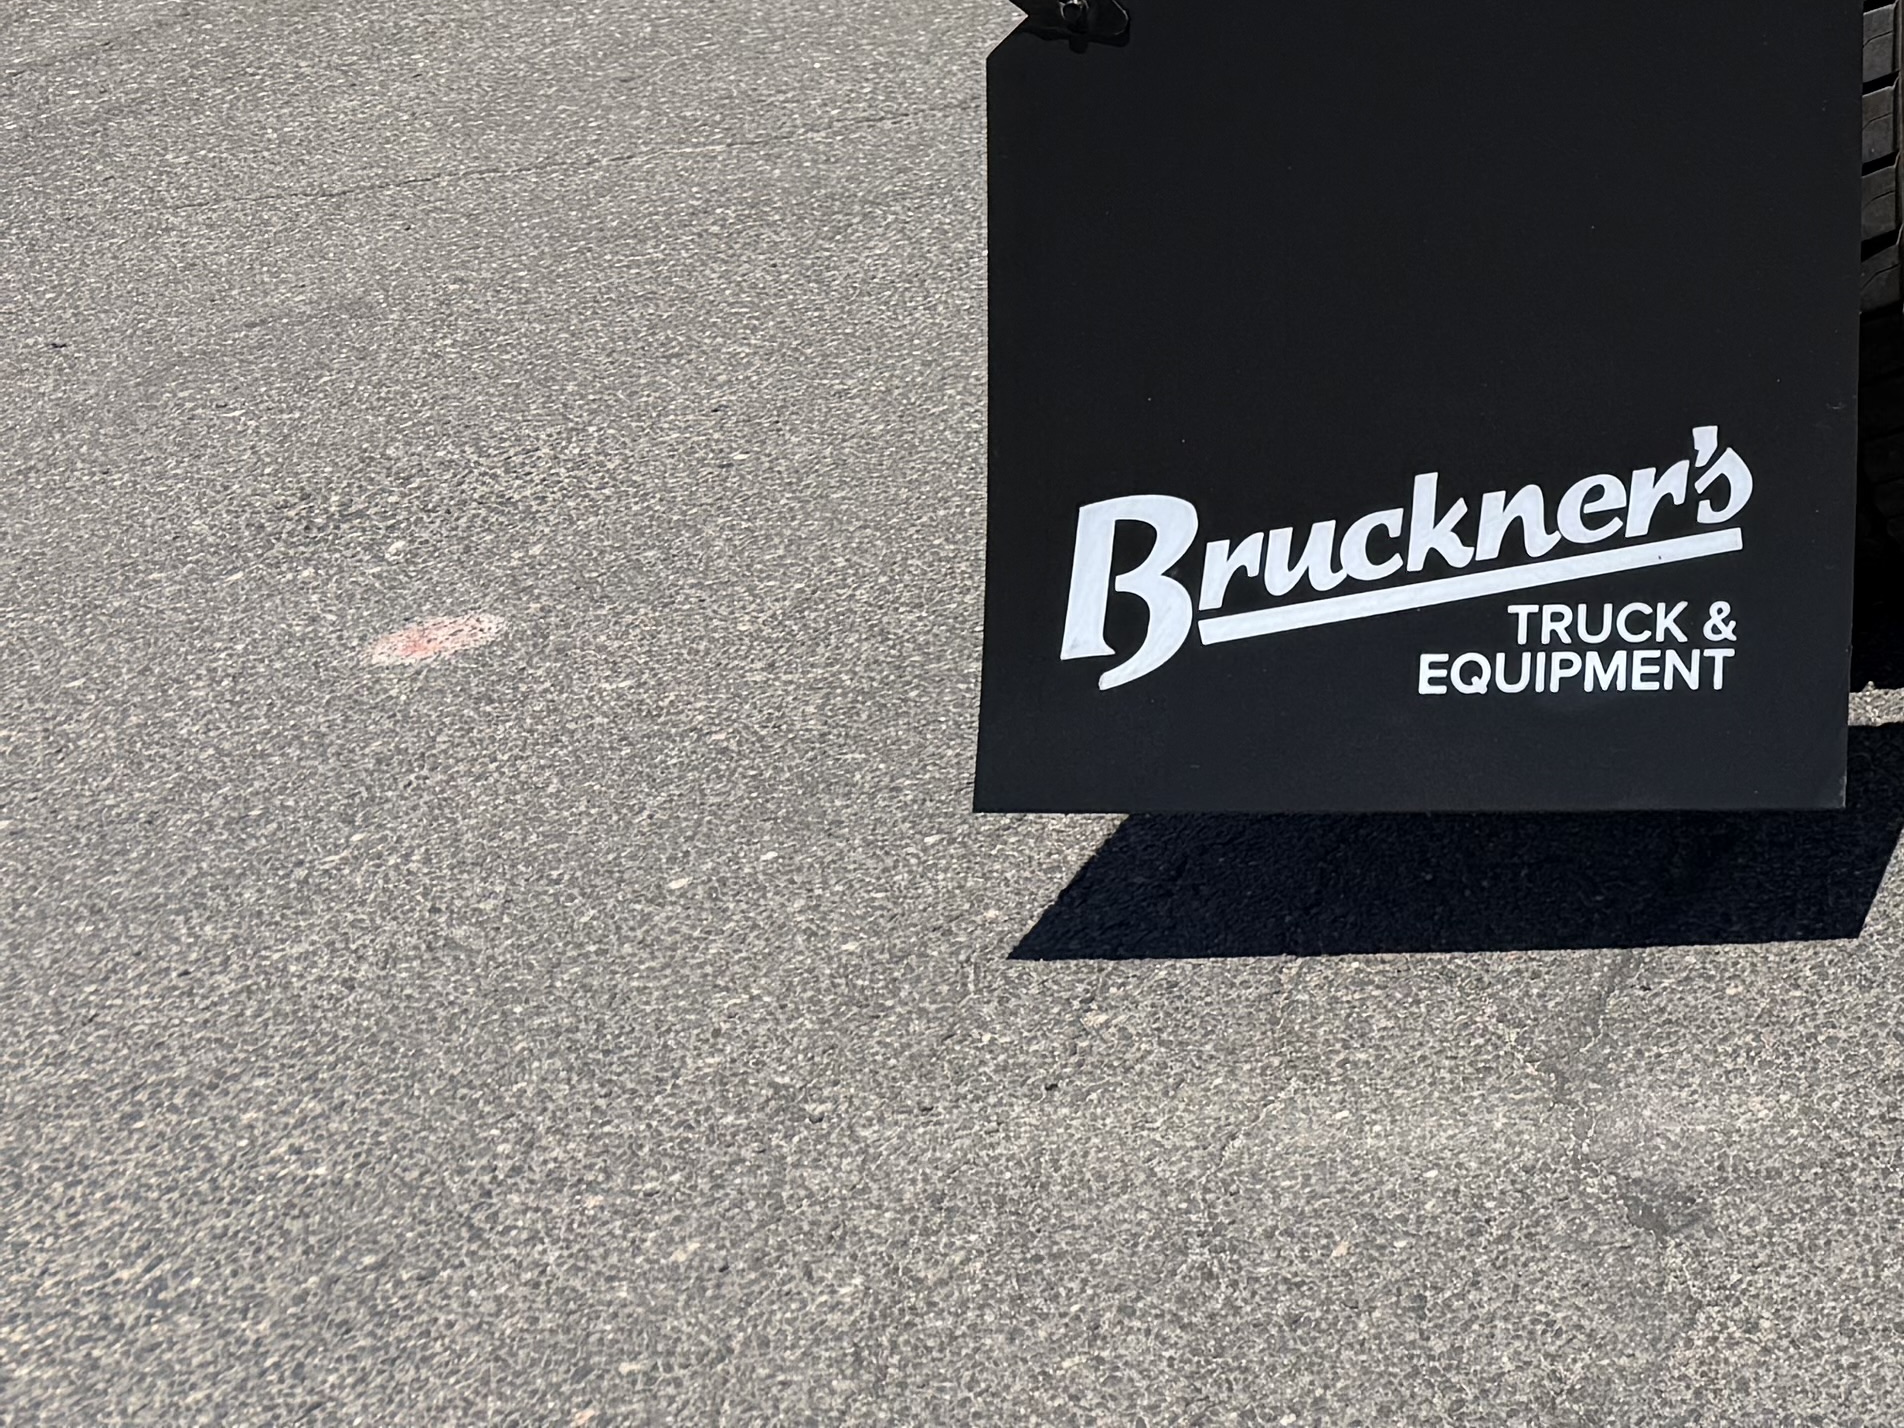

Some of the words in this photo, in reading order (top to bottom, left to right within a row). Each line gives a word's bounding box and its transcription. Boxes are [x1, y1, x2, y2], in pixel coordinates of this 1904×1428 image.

[1059, 425, 1754, 692] Bruckner's
[1507, 600, 1690, 646] TRUCK
[1702, 600, 1738, 644] &
[1418, 647, 1737, 696] EQUIPMENT
